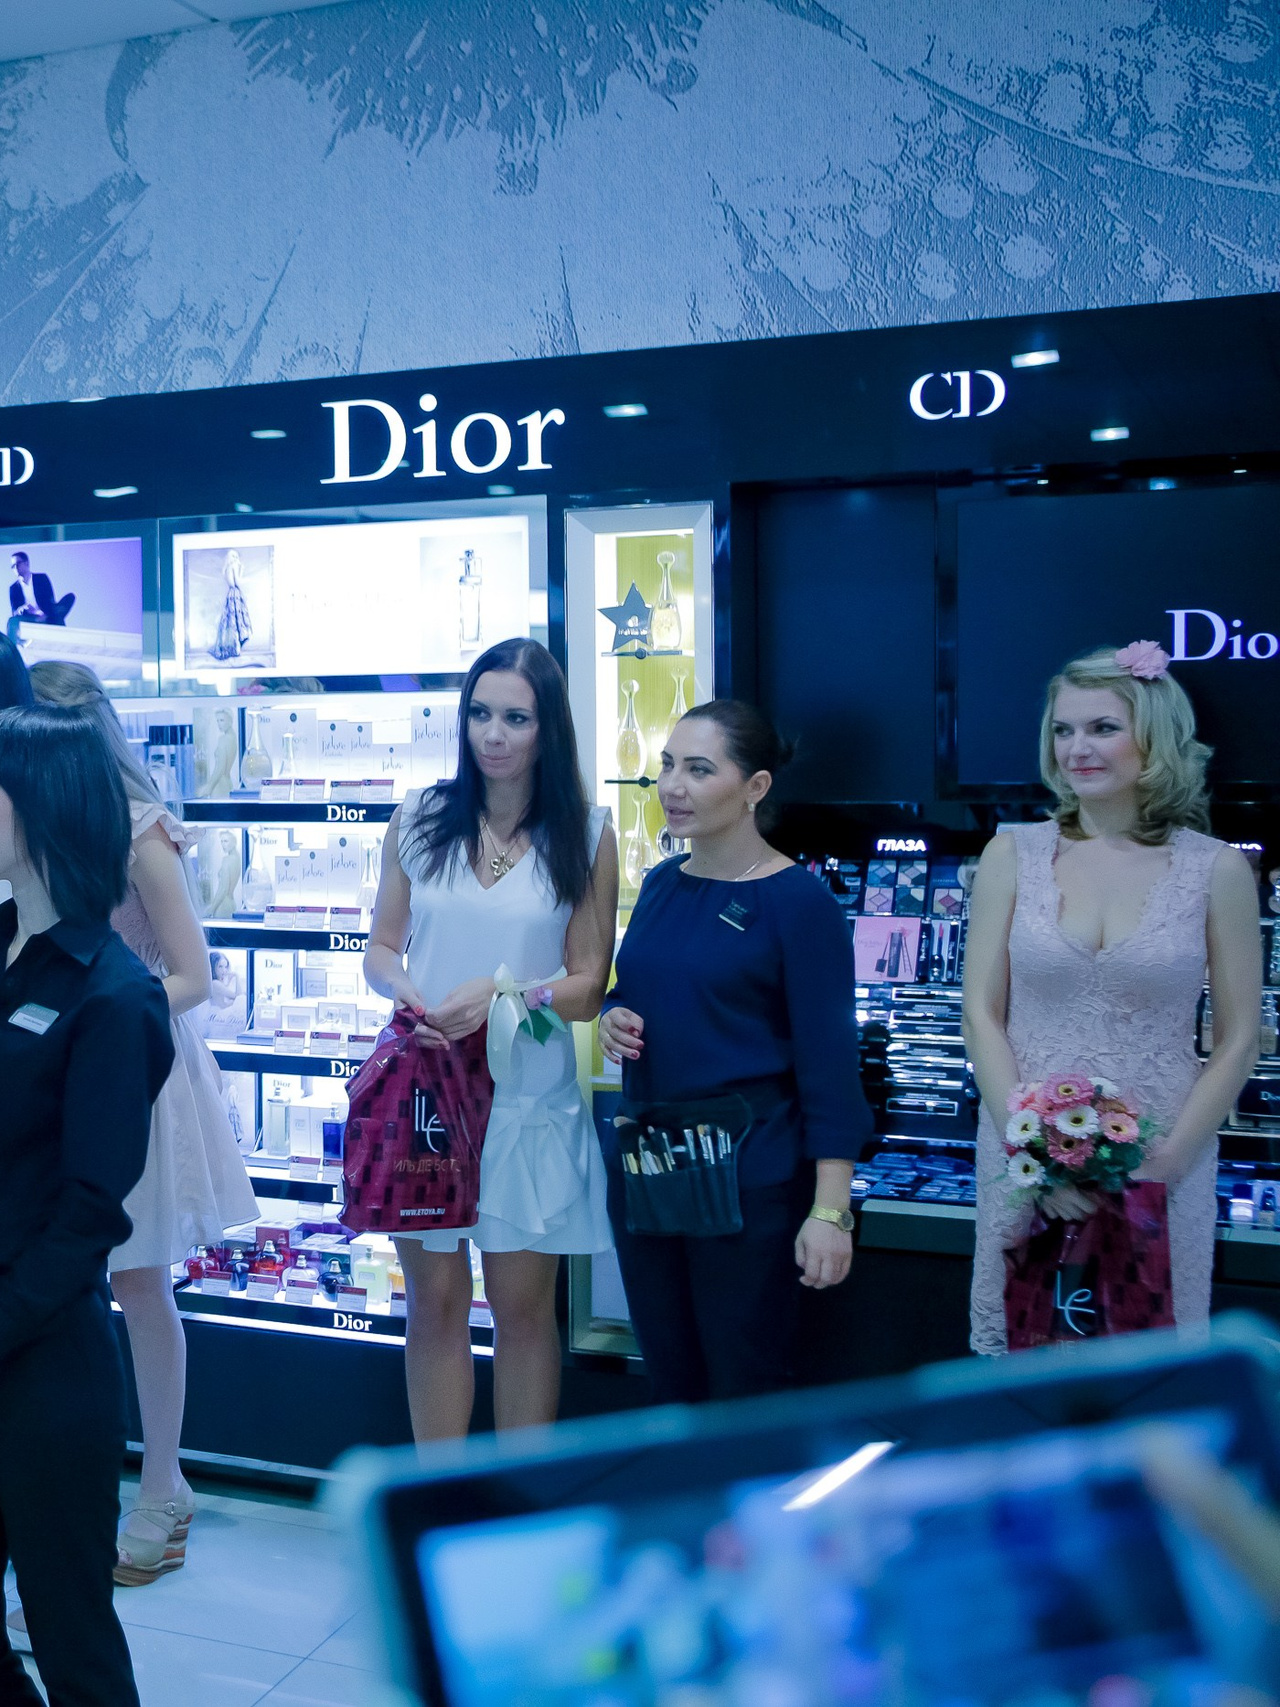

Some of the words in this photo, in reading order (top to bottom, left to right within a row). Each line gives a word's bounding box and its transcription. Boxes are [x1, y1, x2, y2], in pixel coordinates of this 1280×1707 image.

[909, 369, 1006, 420] CD
[320, 393, 566, 484] Dior
[1165, 609, 1280, 661] Dio
[326, 804, 367, 822] Dior
[876, 838, 928, 852] ГЛАЗА
[330, 1060, 360, 1077] Dio
[333, 1312, 373, 1332] Dior
